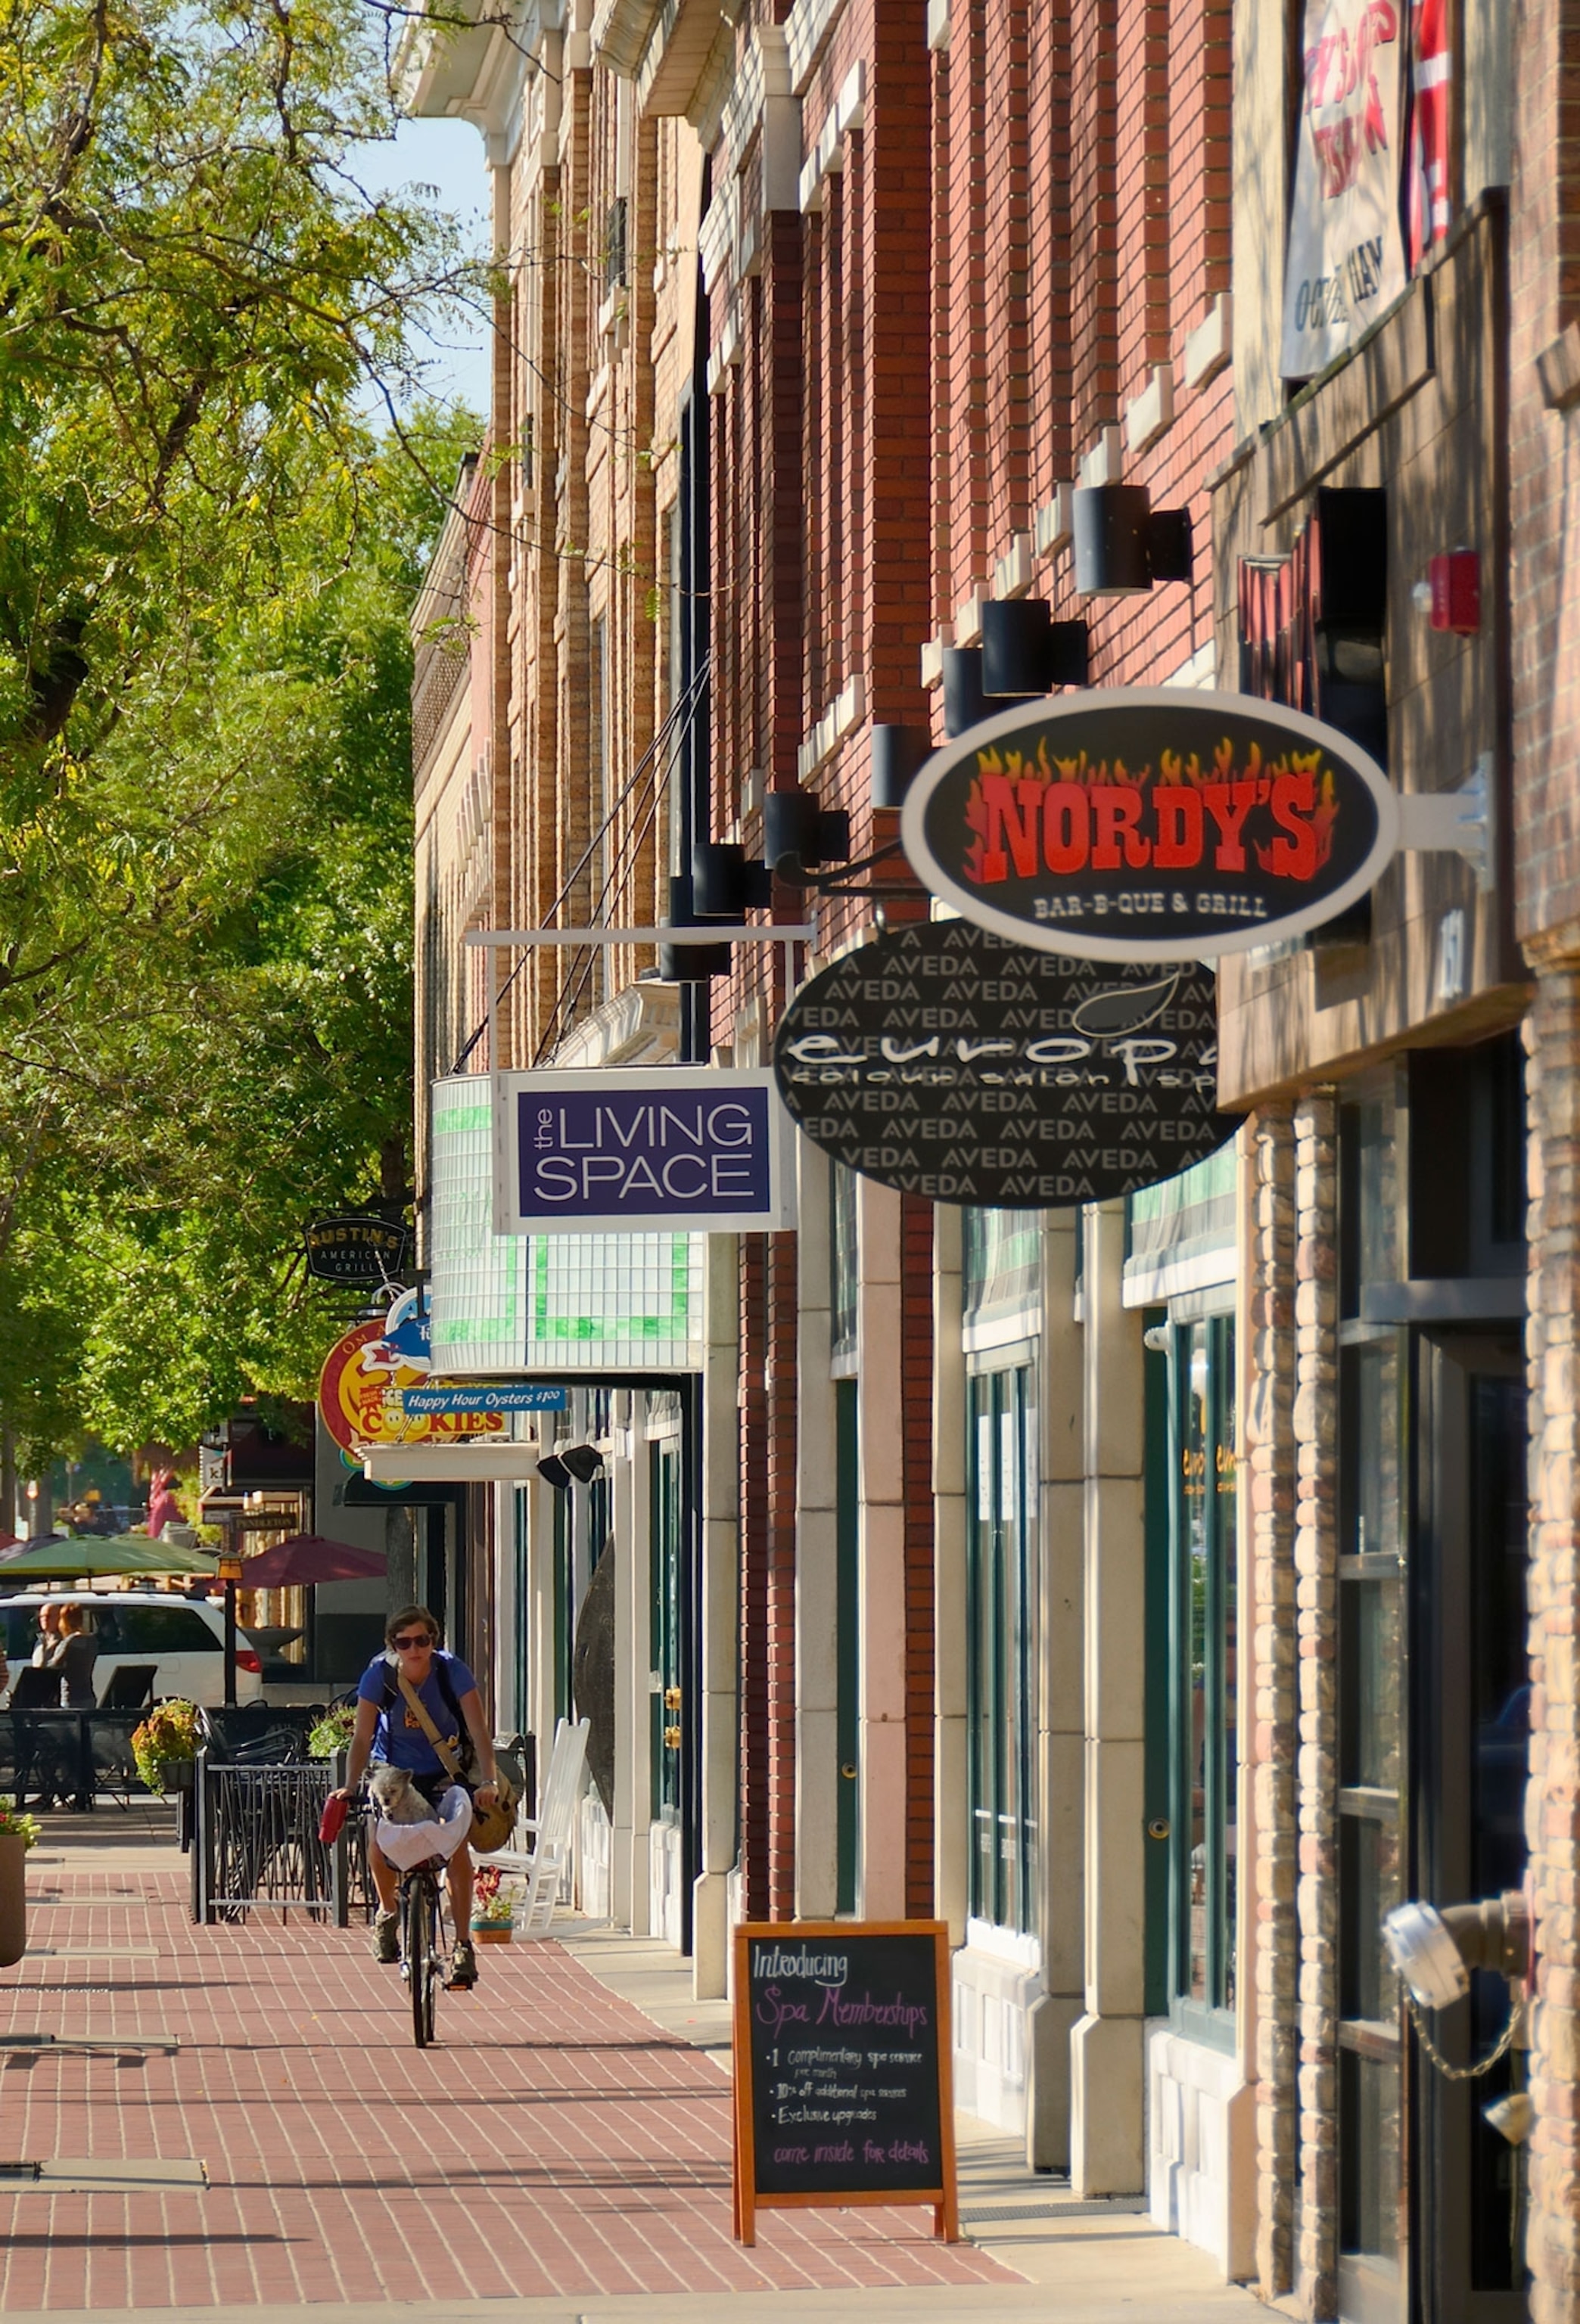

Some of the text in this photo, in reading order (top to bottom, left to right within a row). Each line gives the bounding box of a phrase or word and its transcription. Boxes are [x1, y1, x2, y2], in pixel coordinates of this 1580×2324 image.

[980, 772, 1316, 883] NORDY'S
[1034, 893, 1267, 919] BAR-B-QUE & GRILL
[882, 955, 978, 976] AVEDA
[1000, 957, 1096, 977] AVEDA
[824, 980, 920, 1001] AVEDA
[942, 981, 1038, 1002] AVEDA
[787, 1007, 860, 1028] VEDA
[882, 1008, 978, 1029] AVEDA
[792, 1069, 1216, 1094] colour salon sp
[823, 1091, 920, 1111] AVEDA
[941, 1091, 1038, 1112] AVEDA
[1062, 1092, 1158, 1114] AVEDA
[533, 1102, 754, 1150] the LIVING
[881, 1118, 978, 1139] AVEDA
[999, 1119, 1096, 1139] AVEDA
[1120, 1120, 1216, 1141] AVEDA
[841, 1147, 920, 1167] VEDA
[941, 1147, 1038, 1168] AVEDA
[1062, 1148, 1159, 1170] AVEDA
[533, 1153, 755, 1201] SPACE
[999, 1175, 1096, 1196] AVEDA
[335, 1263, 374, 1272] GRILL
[381, 1387, 403, 1408] ICE
[408, 1395, 449, 1409] Happy
[452, 1393, 483, 1406] Hour
[485, 1392, 533, 1407] Oysters
[754, 1944, 848, 1987] Introducing
[757, 1984, 928, 2040] Spa Memberships
[798, 2081, 813, 2097] off
[774, 2139, 929, 2164] come inside for details
